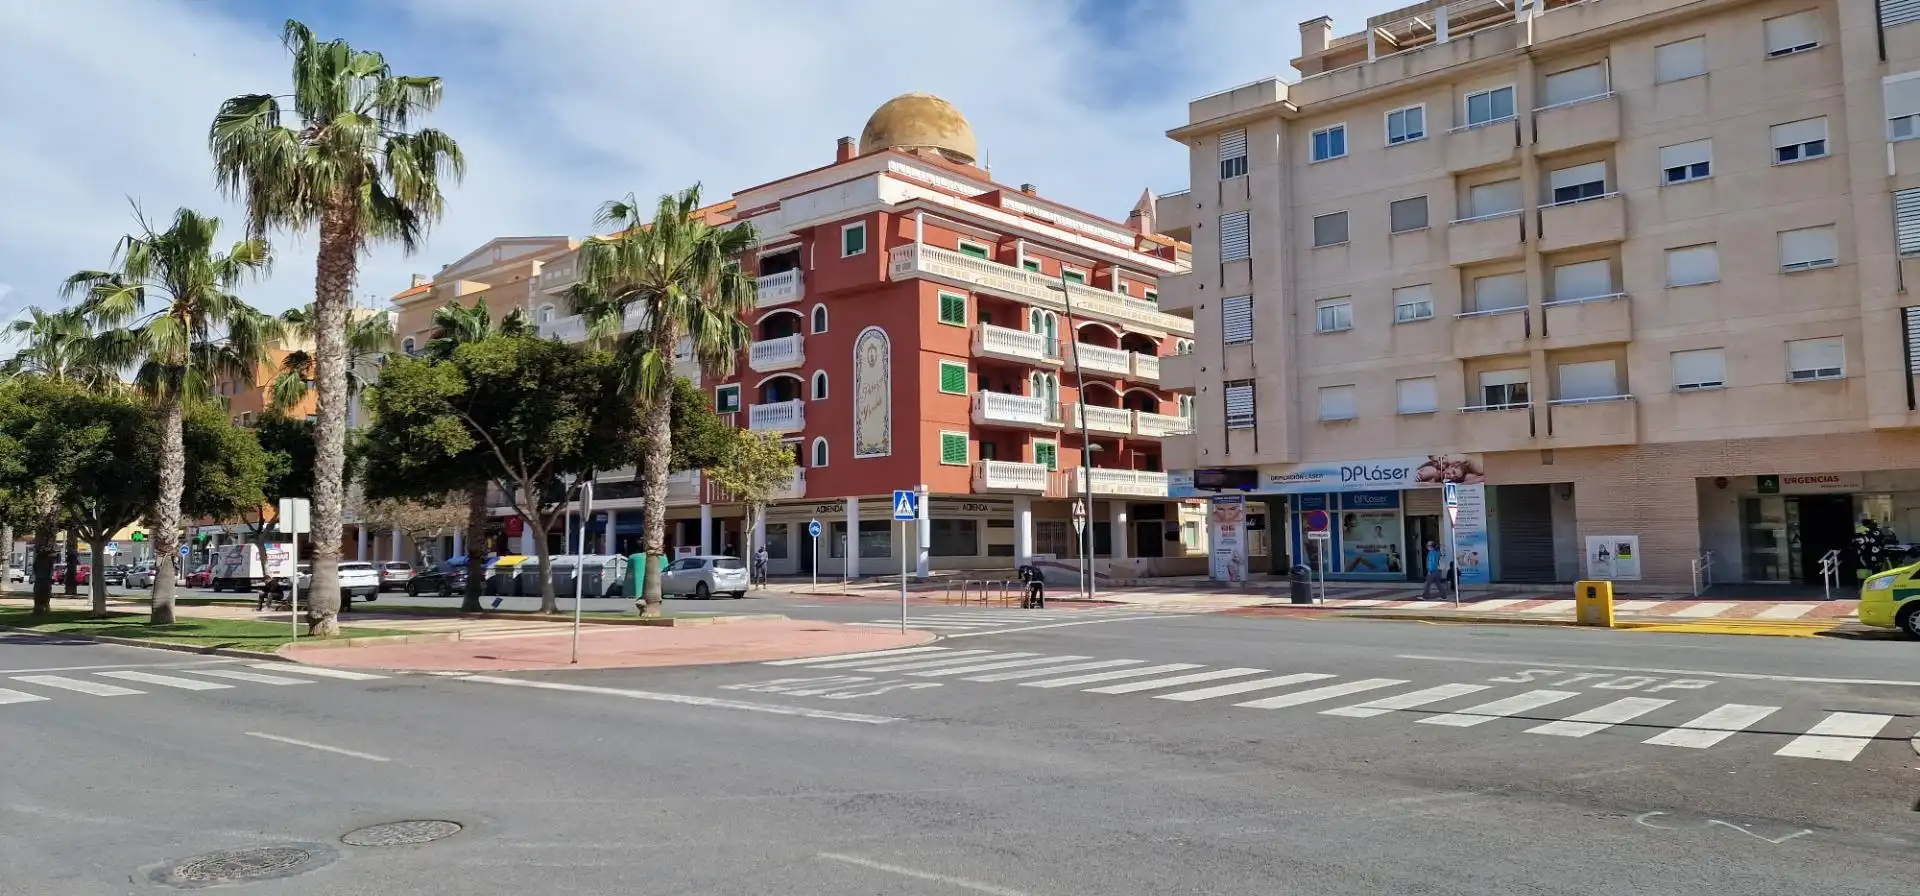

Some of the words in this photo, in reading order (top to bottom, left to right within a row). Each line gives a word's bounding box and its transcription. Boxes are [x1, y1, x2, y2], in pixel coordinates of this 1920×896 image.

[1341, 465, 1410, 482] DPLáser
[1784, 475, 1840, 485] URGENCIAS
[1487, 669, 1719, 693] STOP
